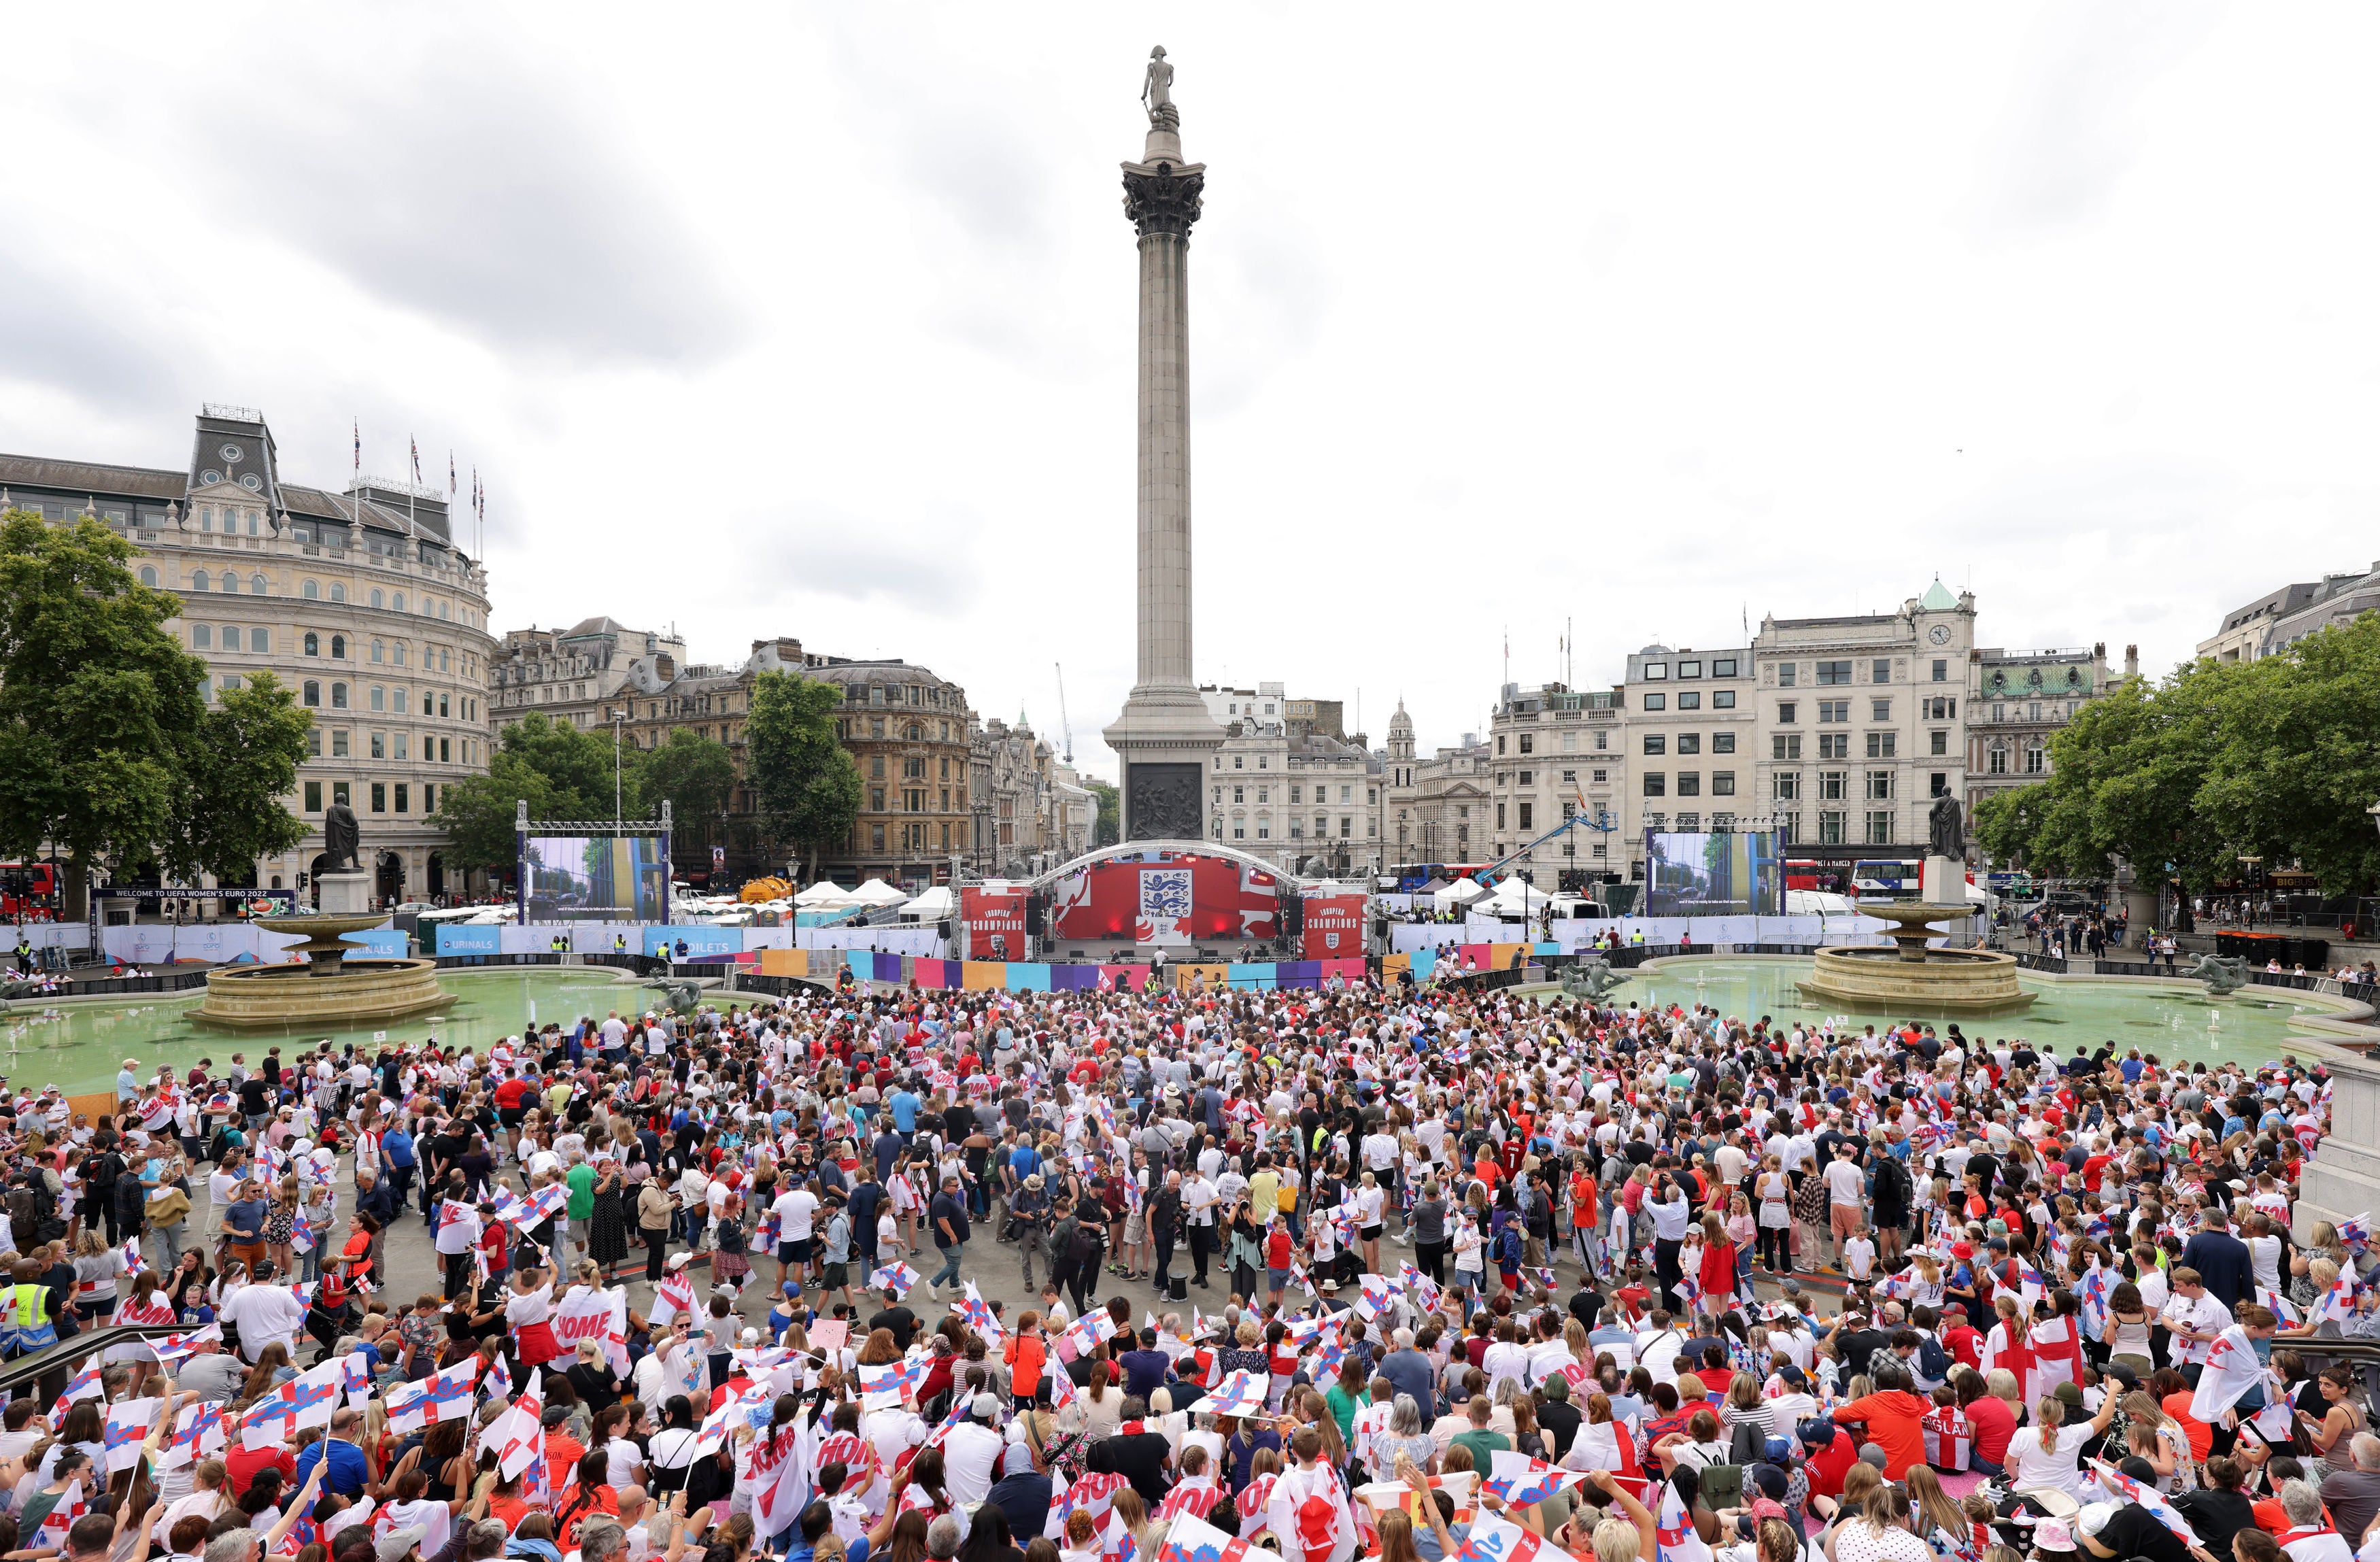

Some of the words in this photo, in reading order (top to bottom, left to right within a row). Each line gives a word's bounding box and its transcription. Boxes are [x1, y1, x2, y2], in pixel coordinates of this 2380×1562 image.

[1778, 629, 1840, 641] CANADIAN
[1845, 626, 1892, 638] PACIFIC
[984, 909, 1010, 919] EUROPEAN
[1319, 907, 1345, 916] EUROPEAN
[972, 919, 1023, 931] CHAMPIONS
[1308, 918, 1357, 929] CHAMPIONS
[452, 939, 493, 949] URINALS
[688, 943, 729, 952] OILETS
[769, 1041, 775, 1052] 6
[557, 1310, 613, 1340] HOME
[1971, 1334, 1986, 1359] 6
[1920, 1415, 1970, 1437] ENGLAN
